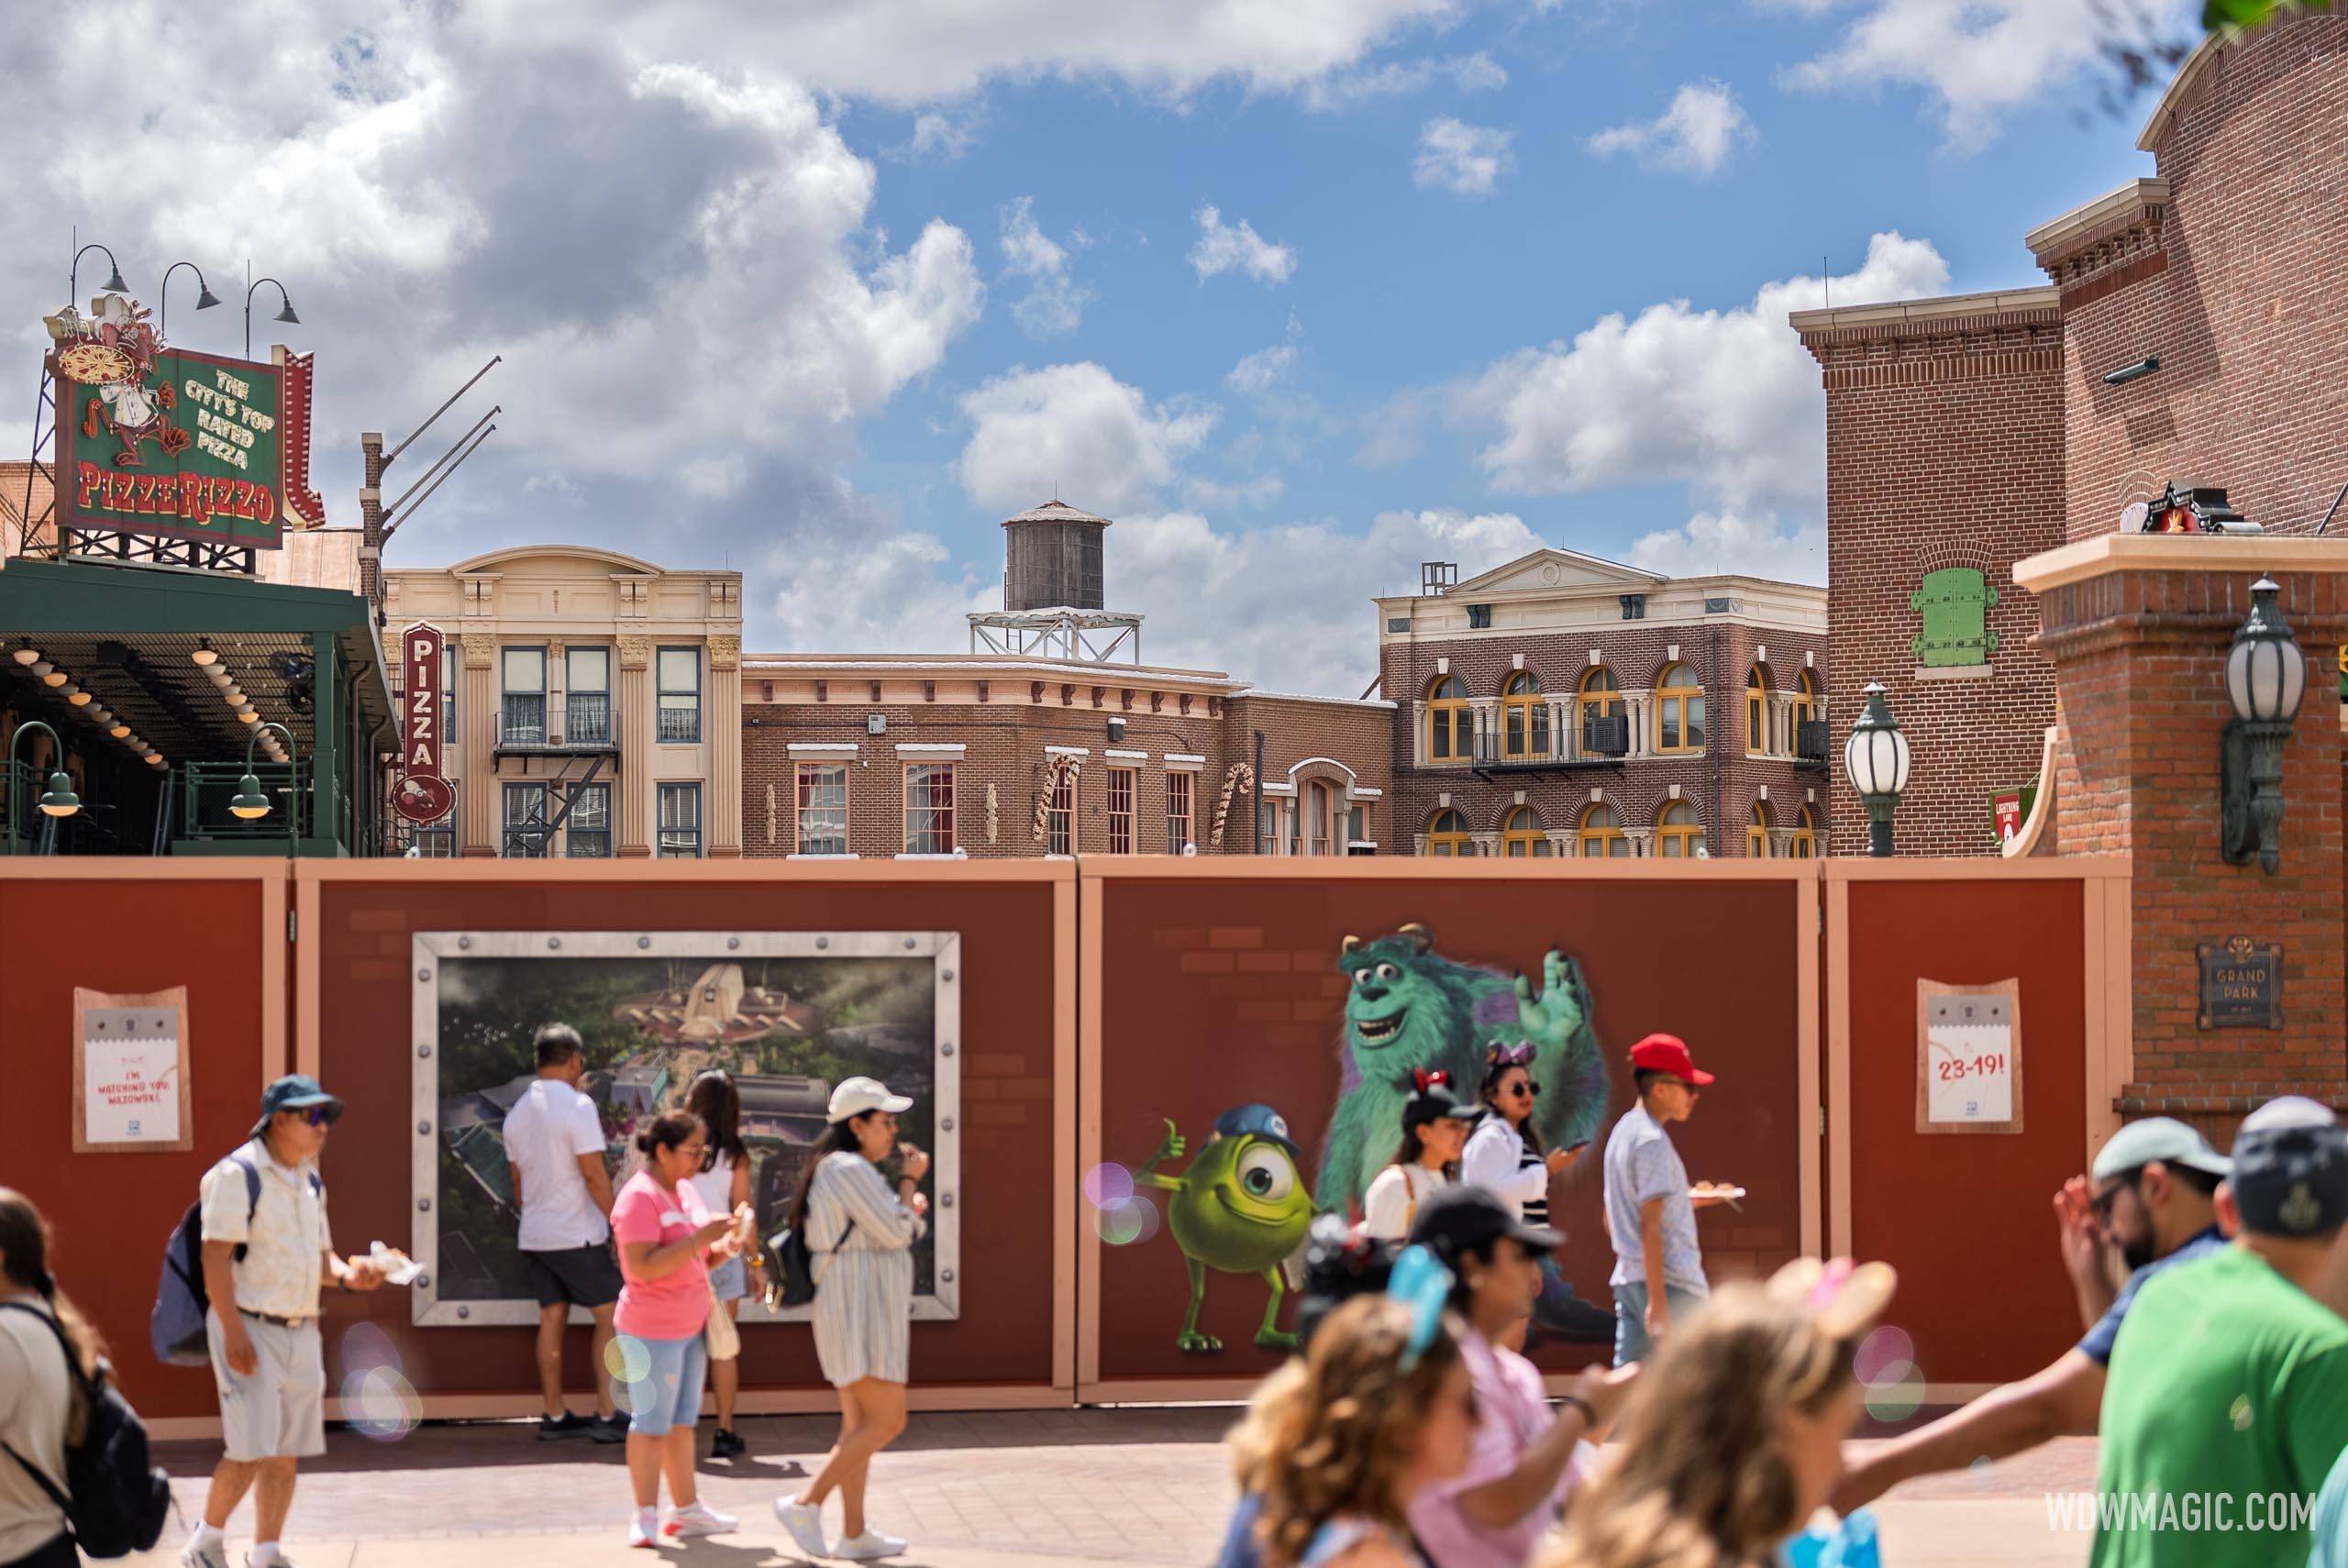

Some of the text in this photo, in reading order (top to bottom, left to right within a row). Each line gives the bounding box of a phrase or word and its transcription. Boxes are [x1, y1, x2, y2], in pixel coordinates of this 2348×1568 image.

[216, 369, 250, 402] THE
[184, 379, 275, 433] CITY'S TOP
[197, 408, 255, 448] RATED
[197, 430, 249, 470] PIZZA
[77, 460, 274, 525] PIZZERIZZO
[411, 639, 434, 767] PIZZA
[1995, 801, 2020, 815] LIGHTNING
[2002, 812, 2013, 823] LANE
[2216, 969, 2265, 984] GRAND
[2223, 986, 2259, 999] PARK
[1938, 1054, 2004, 1082] 23-19!
[96, 1083, 146, 1095] WATCHING
